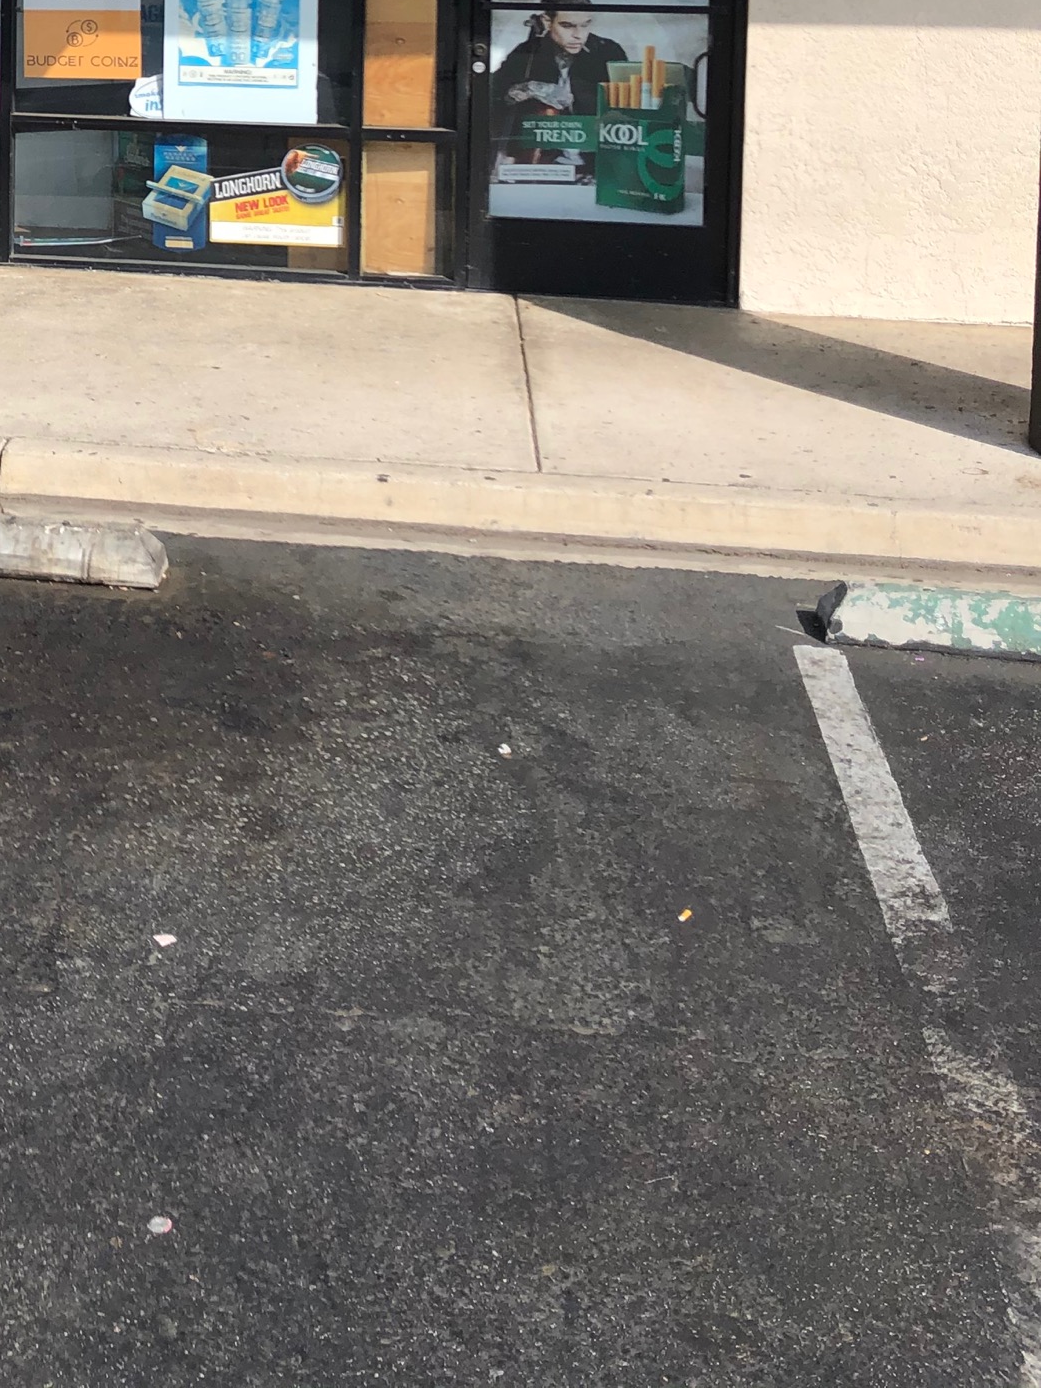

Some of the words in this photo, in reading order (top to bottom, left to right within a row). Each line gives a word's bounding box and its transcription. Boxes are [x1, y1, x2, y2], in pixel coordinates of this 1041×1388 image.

[26, 55, 84, 67] BUDGET
[90, 55, 139, 68] COINZ
[534, 129, 587, 143] TREND
[599, 123, 649, 146] KOOL
[214, 172, 282, 199] LONGHORN
[234, 199, 259, 213] NEW
[263, 195, 289, 209] LOOK
